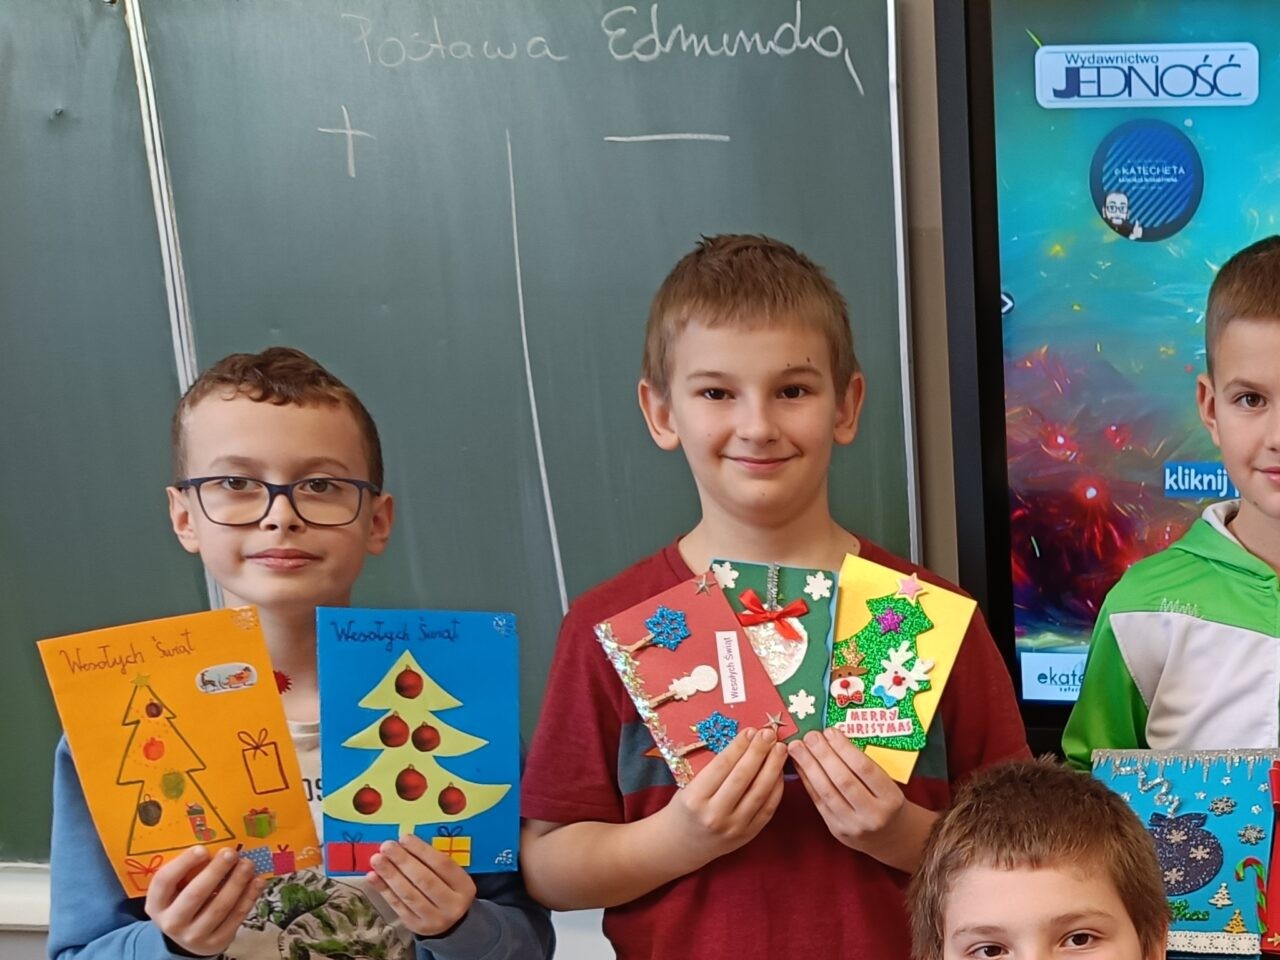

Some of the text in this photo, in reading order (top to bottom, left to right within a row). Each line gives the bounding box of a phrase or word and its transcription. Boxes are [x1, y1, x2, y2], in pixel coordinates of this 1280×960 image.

[340, 13, 569, 67] Postawa
[1065, 53, 1159, 67] Wydawnictwo
[1052, 54, 1242, 99] JEDNOŚĆ
[1164, 467, 1229, 497] kliknij
[59, 642, 145, 676] Wesołych
[838, 720, 912, 735] CHRISTMAS
[850, 709, 898, 722] MERRY
